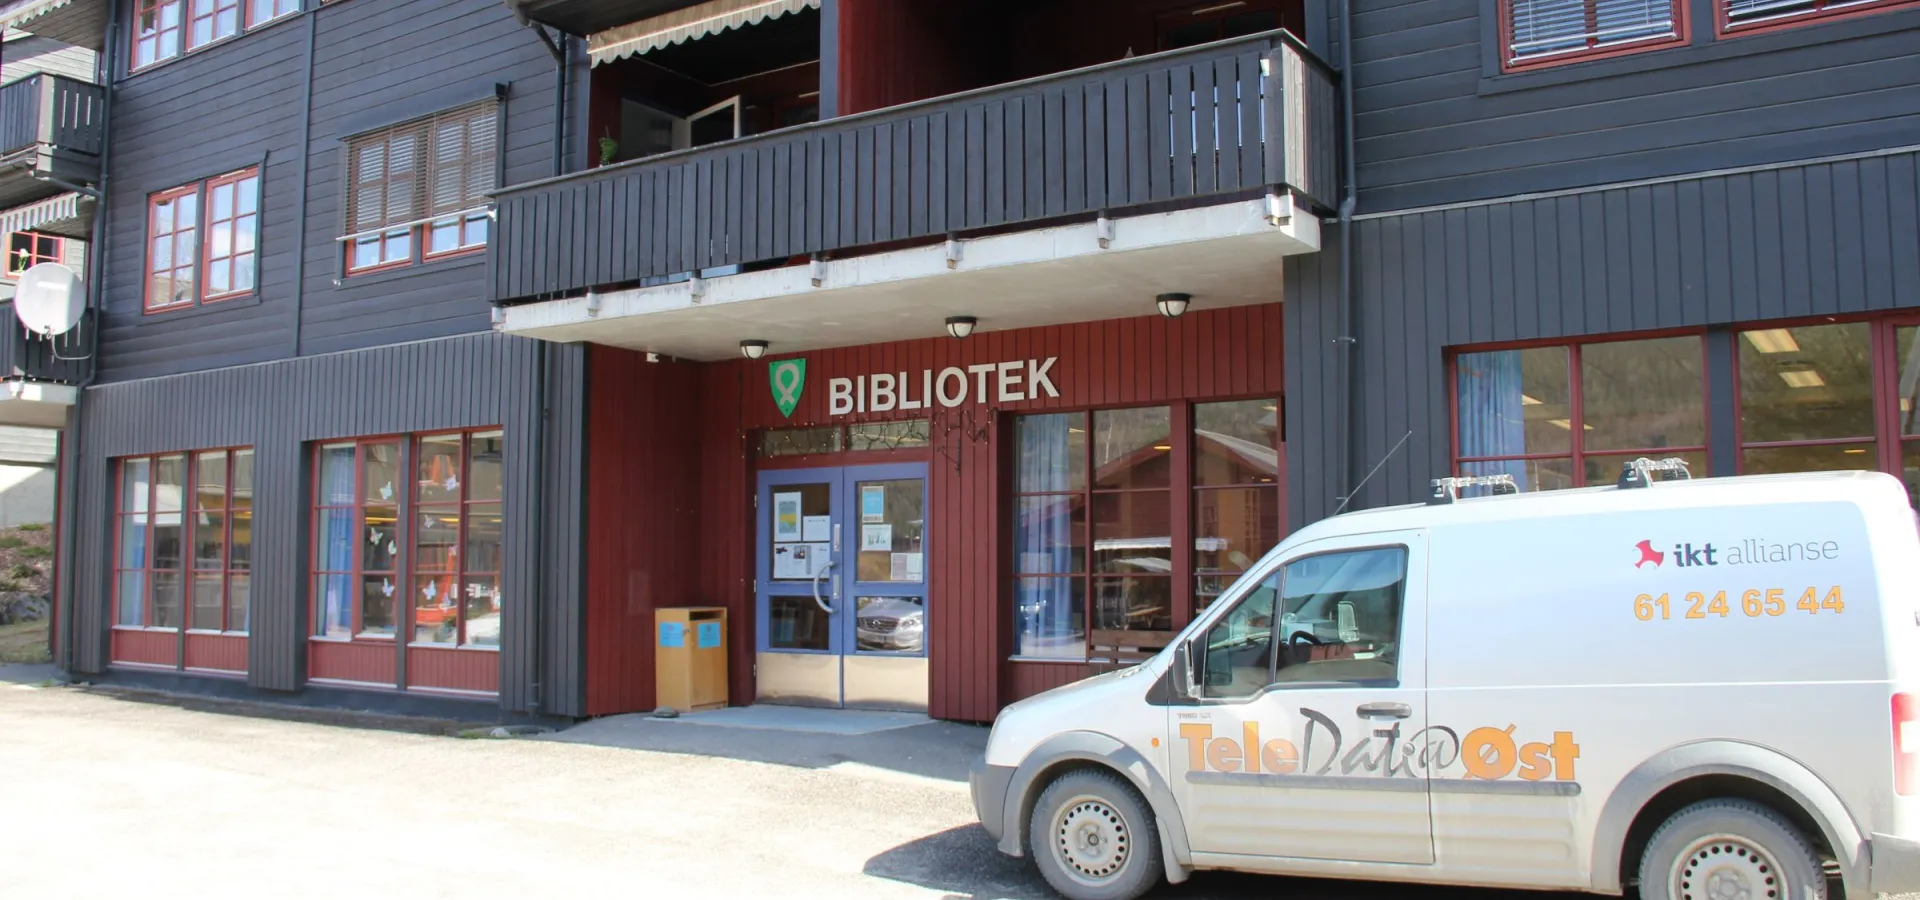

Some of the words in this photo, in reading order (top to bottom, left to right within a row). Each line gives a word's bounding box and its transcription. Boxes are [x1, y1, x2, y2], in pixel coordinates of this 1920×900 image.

[829, 357, 1060, 415] BIBLIOTEK
[1673, 542, 1718, 567] ikt
[1727, 538, 1839, 565] allianse
[1634, 592, 1671, 621] 61
[1685, 590, 1729, 619] 24
[1741, 588, 1786, 617] 65
[1796, 585, 1845, 615] 44
